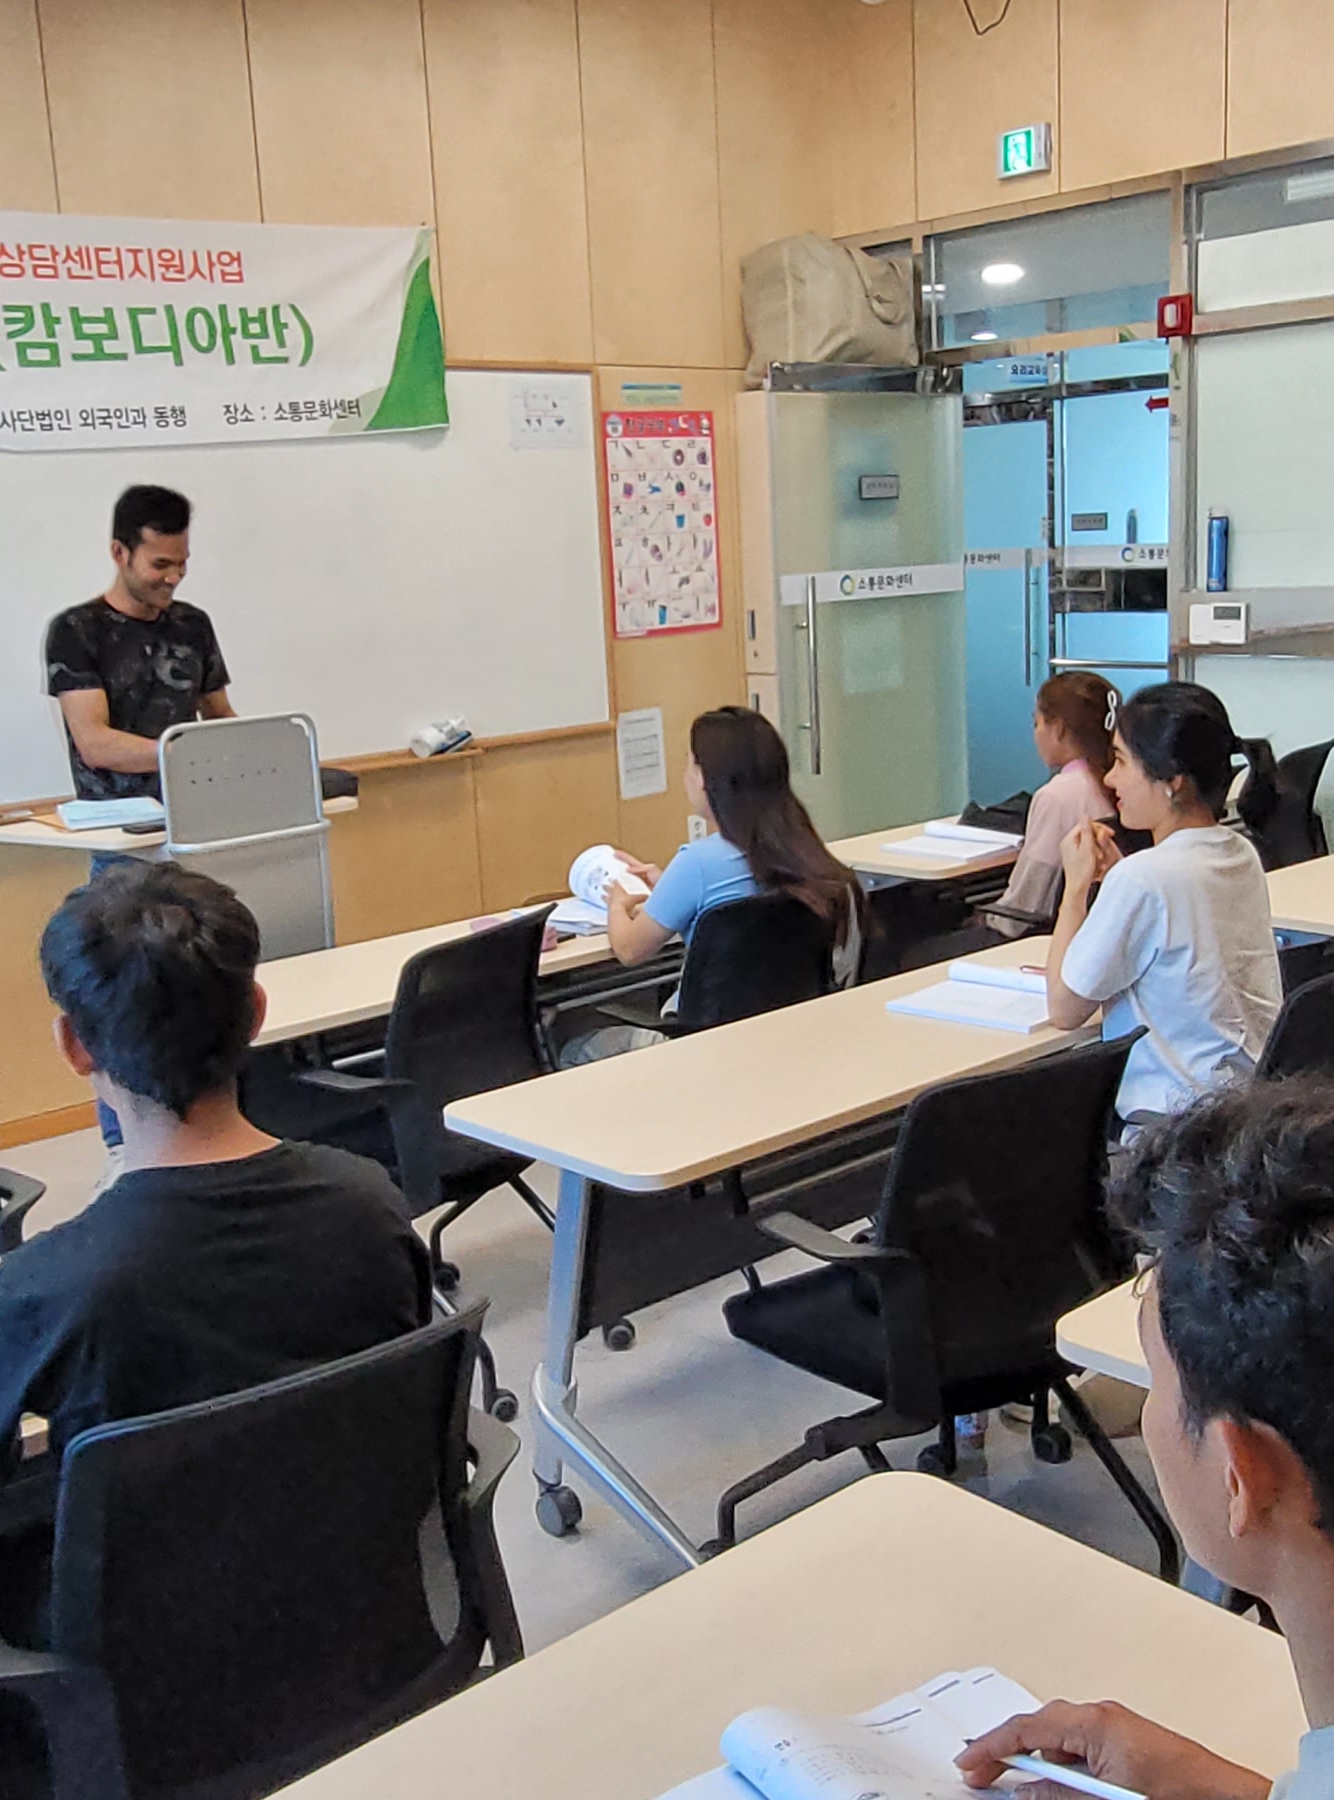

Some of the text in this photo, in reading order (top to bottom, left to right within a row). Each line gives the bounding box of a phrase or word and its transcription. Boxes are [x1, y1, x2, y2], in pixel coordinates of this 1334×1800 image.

[0, 408, 72, 433] 사단법인
[78, 406, 146, 431] 외국인과
[153, 405, 187, 428] 동행
[223, 403, 255, 425] 장소
[274, 398, 361, 422] 소통문화센터
[857, 573, 913, 590] 소통문화센터
